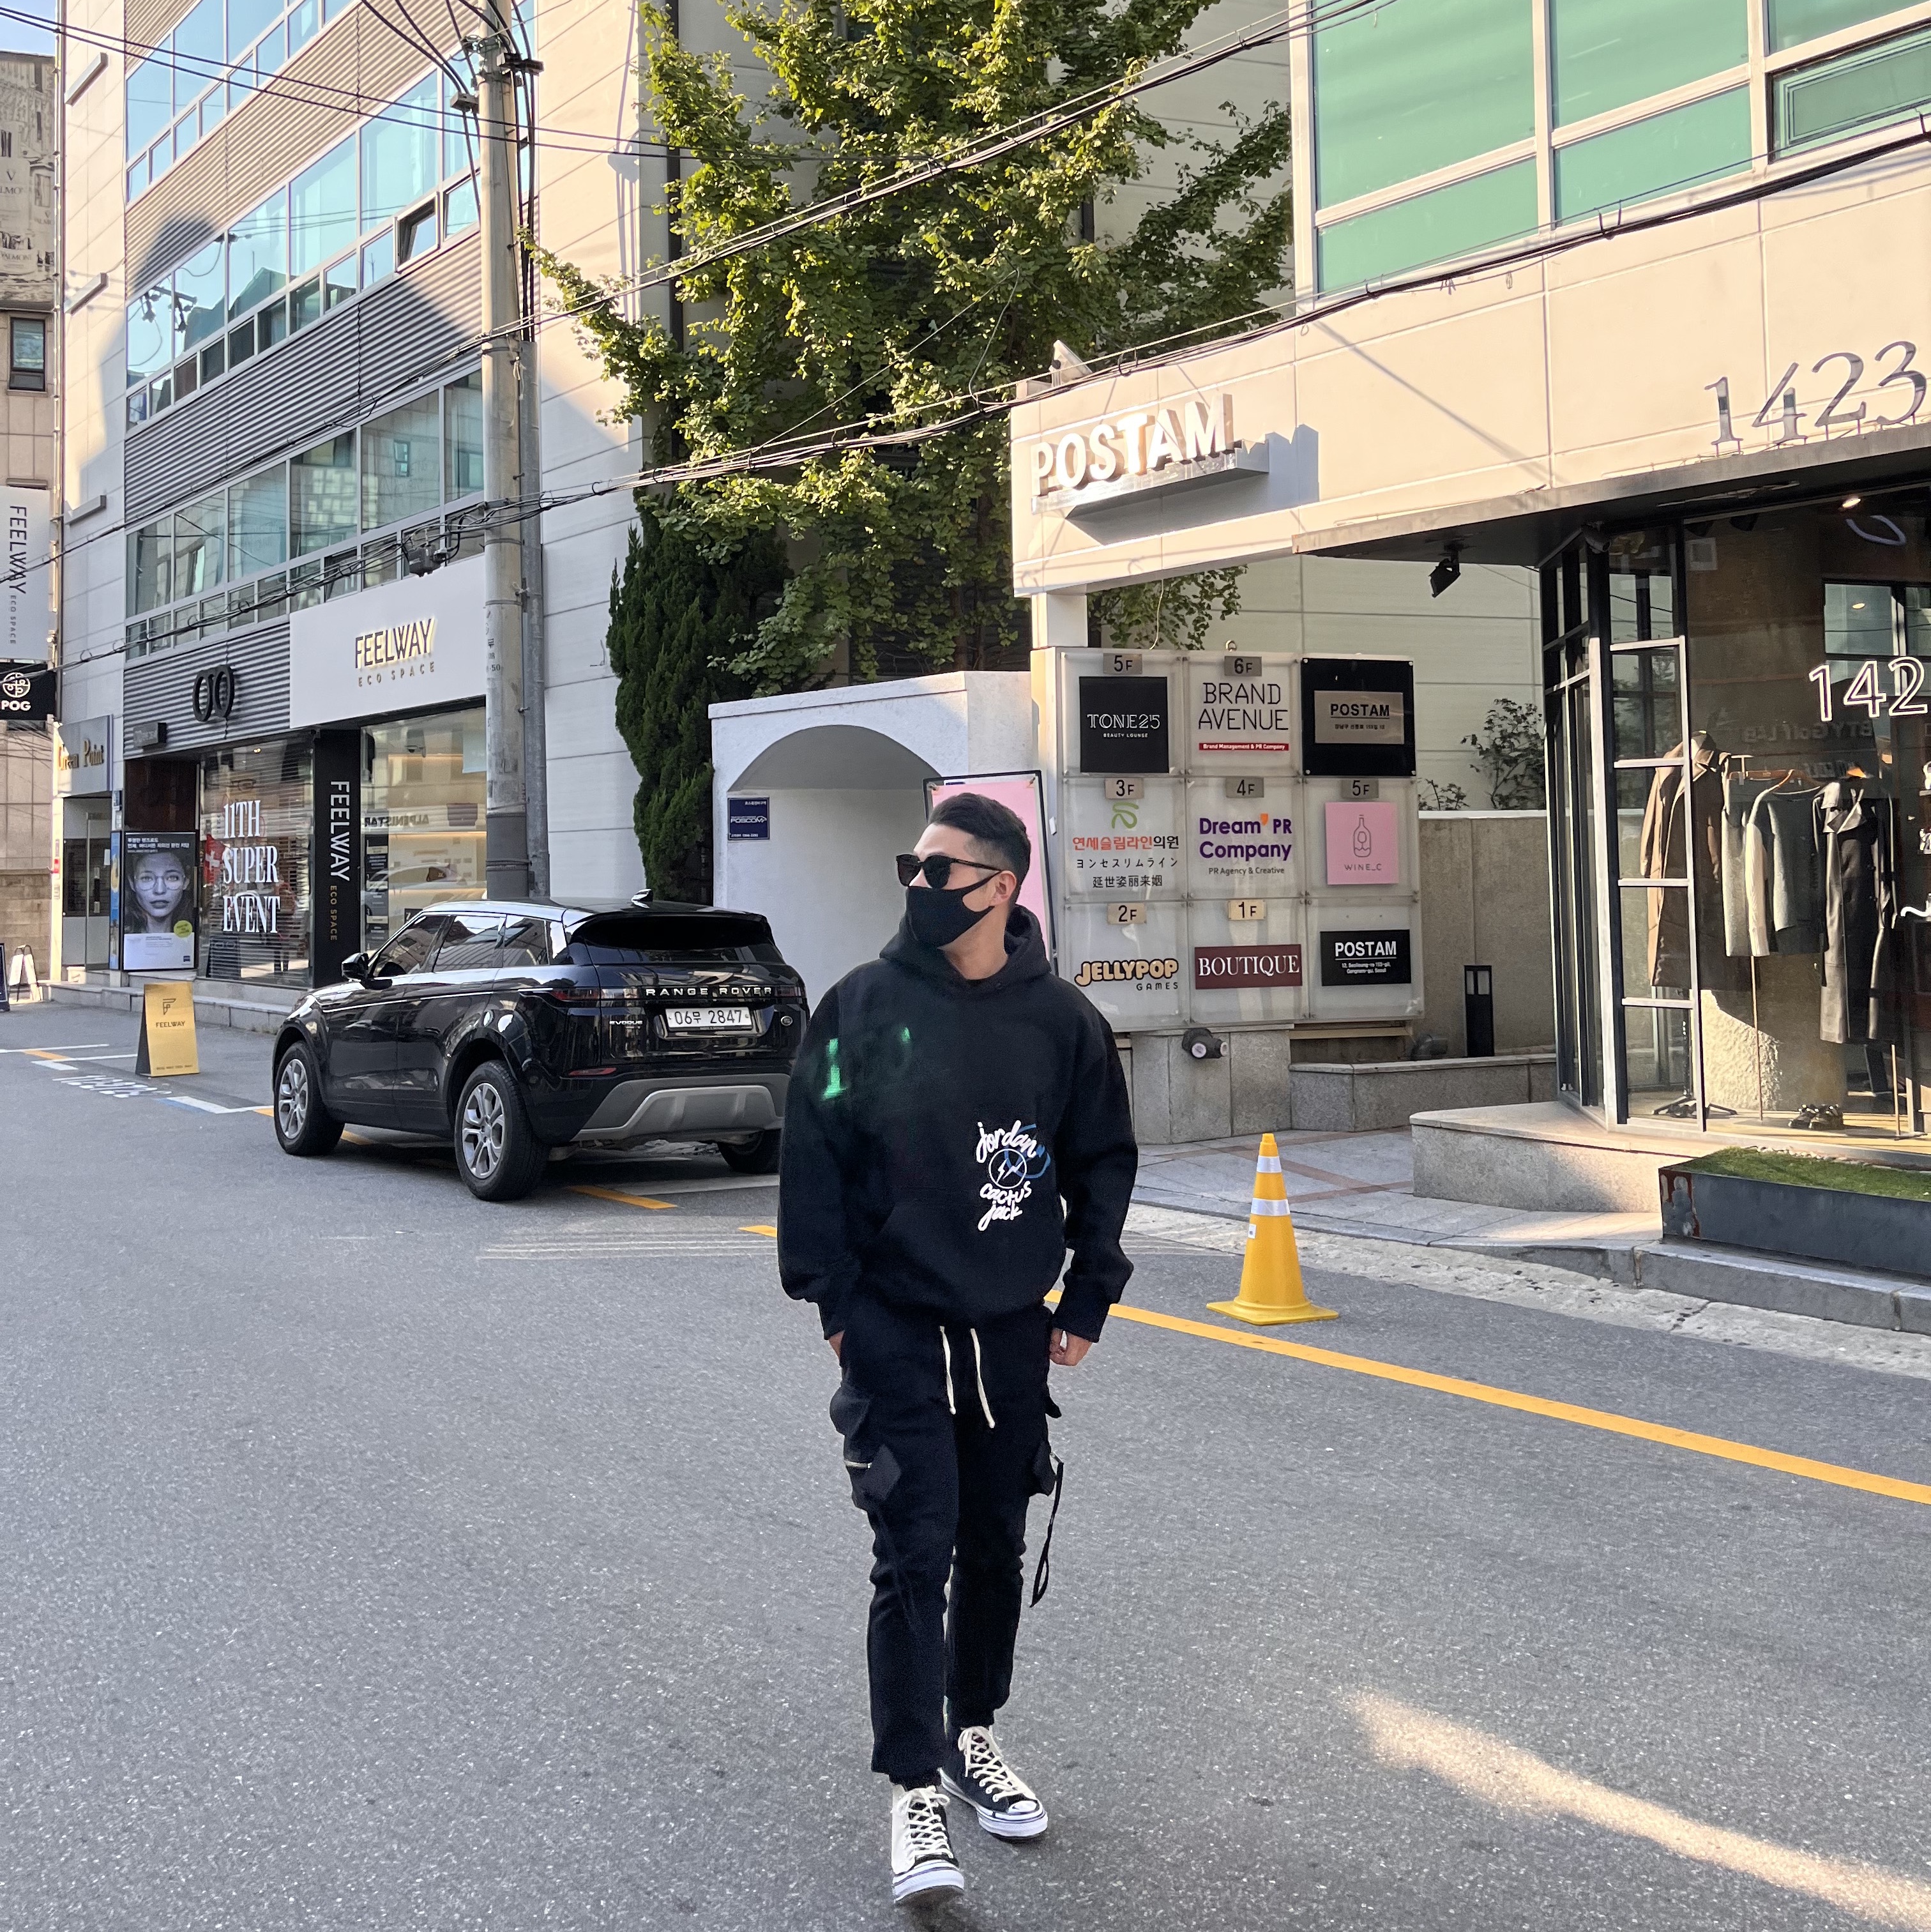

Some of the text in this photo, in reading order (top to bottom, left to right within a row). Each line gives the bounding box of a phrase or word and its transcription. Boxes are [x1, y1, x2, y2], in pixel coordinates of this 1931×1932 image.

[1704, 340, 1927, 446] 1423
[1031, 393, 1234, 496] POSTAM
[10, 505, 27, 595] FEELWAY
[355, 618, 434, 669] FEELWAY
[358, 661, 434, 687] ECO SPACE
[1114, 655, 1133, 672] 5F
[1234, 658, 1253, 674] 6F
[1202, 683, 1281, 704] BRAND
[1809, 657, 1928, 722] 142
[1, 700, 31, 711] POG
[1330, 703, 1390, 717] POSTAM
[1087, 713, 1160, 729] TONE25
[1199, 708, 1289, 730] AVENUE
[84, 738, 104, 768] Point
[1116, 779, 1135, 797] 3F
[1236, 779, 1255, 796] 4F
[1352, 780, 1370, 796] 5F
[223, 800, 261, 839] 11TH
[1273, 819, 1292, 834] PR
[330, 781, 350, 881] FEELWAY
[1073, 835, 1179, 851] 연세슬림라인의원
[1199, 840, 1292, 862] Company
[223, 845, 279, 884] SUPER
[1077, 857, 1178, 869] ヨンセスリムライン
[1220, 867, 1246, 876] Agency
[223, 895, 280, 933] EVENT
[1118, 904, 1137, 922] 2F
[1238, 901, 1257, 918] 1F
[329, 909, 338, 941] SPACE
[1335, 941, 1397, 957] POSTAM
[1074, 958, 1179, 987] JELLYPOP
[1198, 955, 1299, 977] BOUTIQUE
[646, 987, 772, 996] RANGE ROVER
[1136, 982, 1178, 991] GAMES
[674, 1010, 742, 1024] 06무 2847
[976, 1120, 1038, 1164] jordan
[980, 1180, 1032, 1206] cactus
[978, 1200, 1023, 1231] jack
